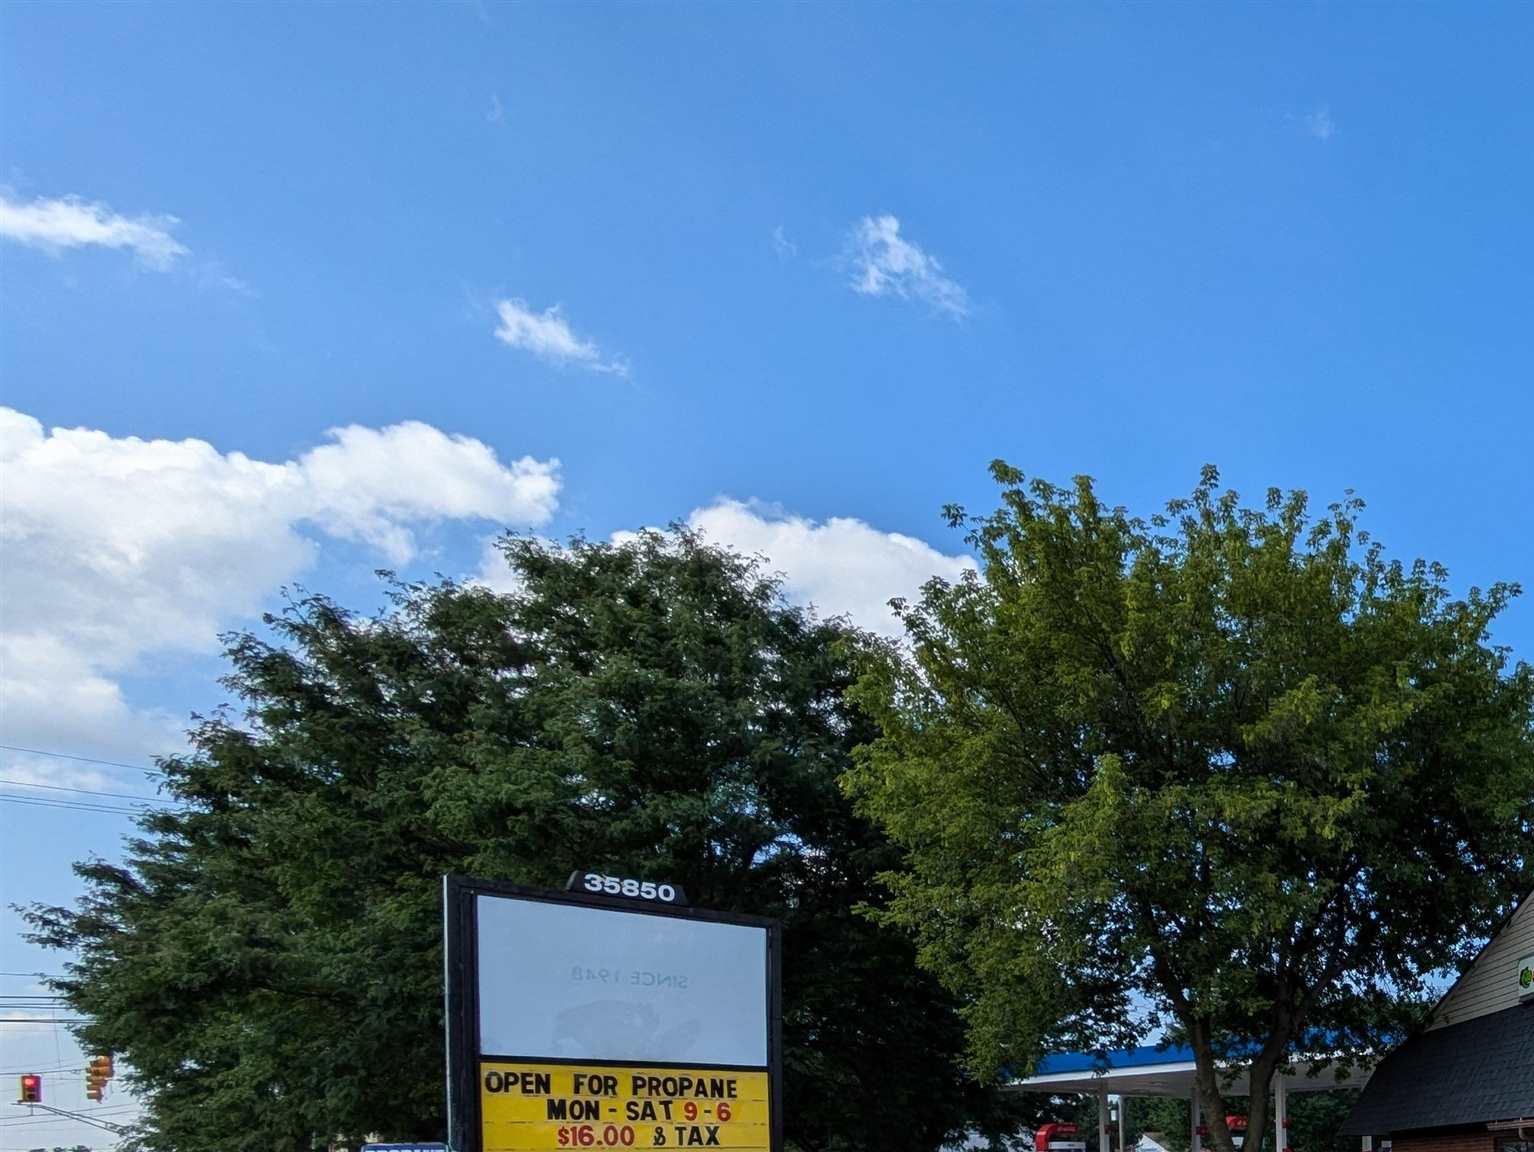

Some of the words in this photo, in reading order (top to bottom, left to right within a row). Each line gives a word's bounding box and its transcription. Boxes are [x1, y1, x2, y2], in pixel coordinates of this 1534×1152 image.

[584, 874, 675, 901] 35850
[484, 1072, 551, 1095] OPEN
[573, 1073, 618, 1096] FOR
[632, 1076, 738, 1098] PROPANE
[558, 1125, 635, 1146] $16.00
[653, 1126, 666, 1146] &
[675, 1126, 720, 1146] TAX
